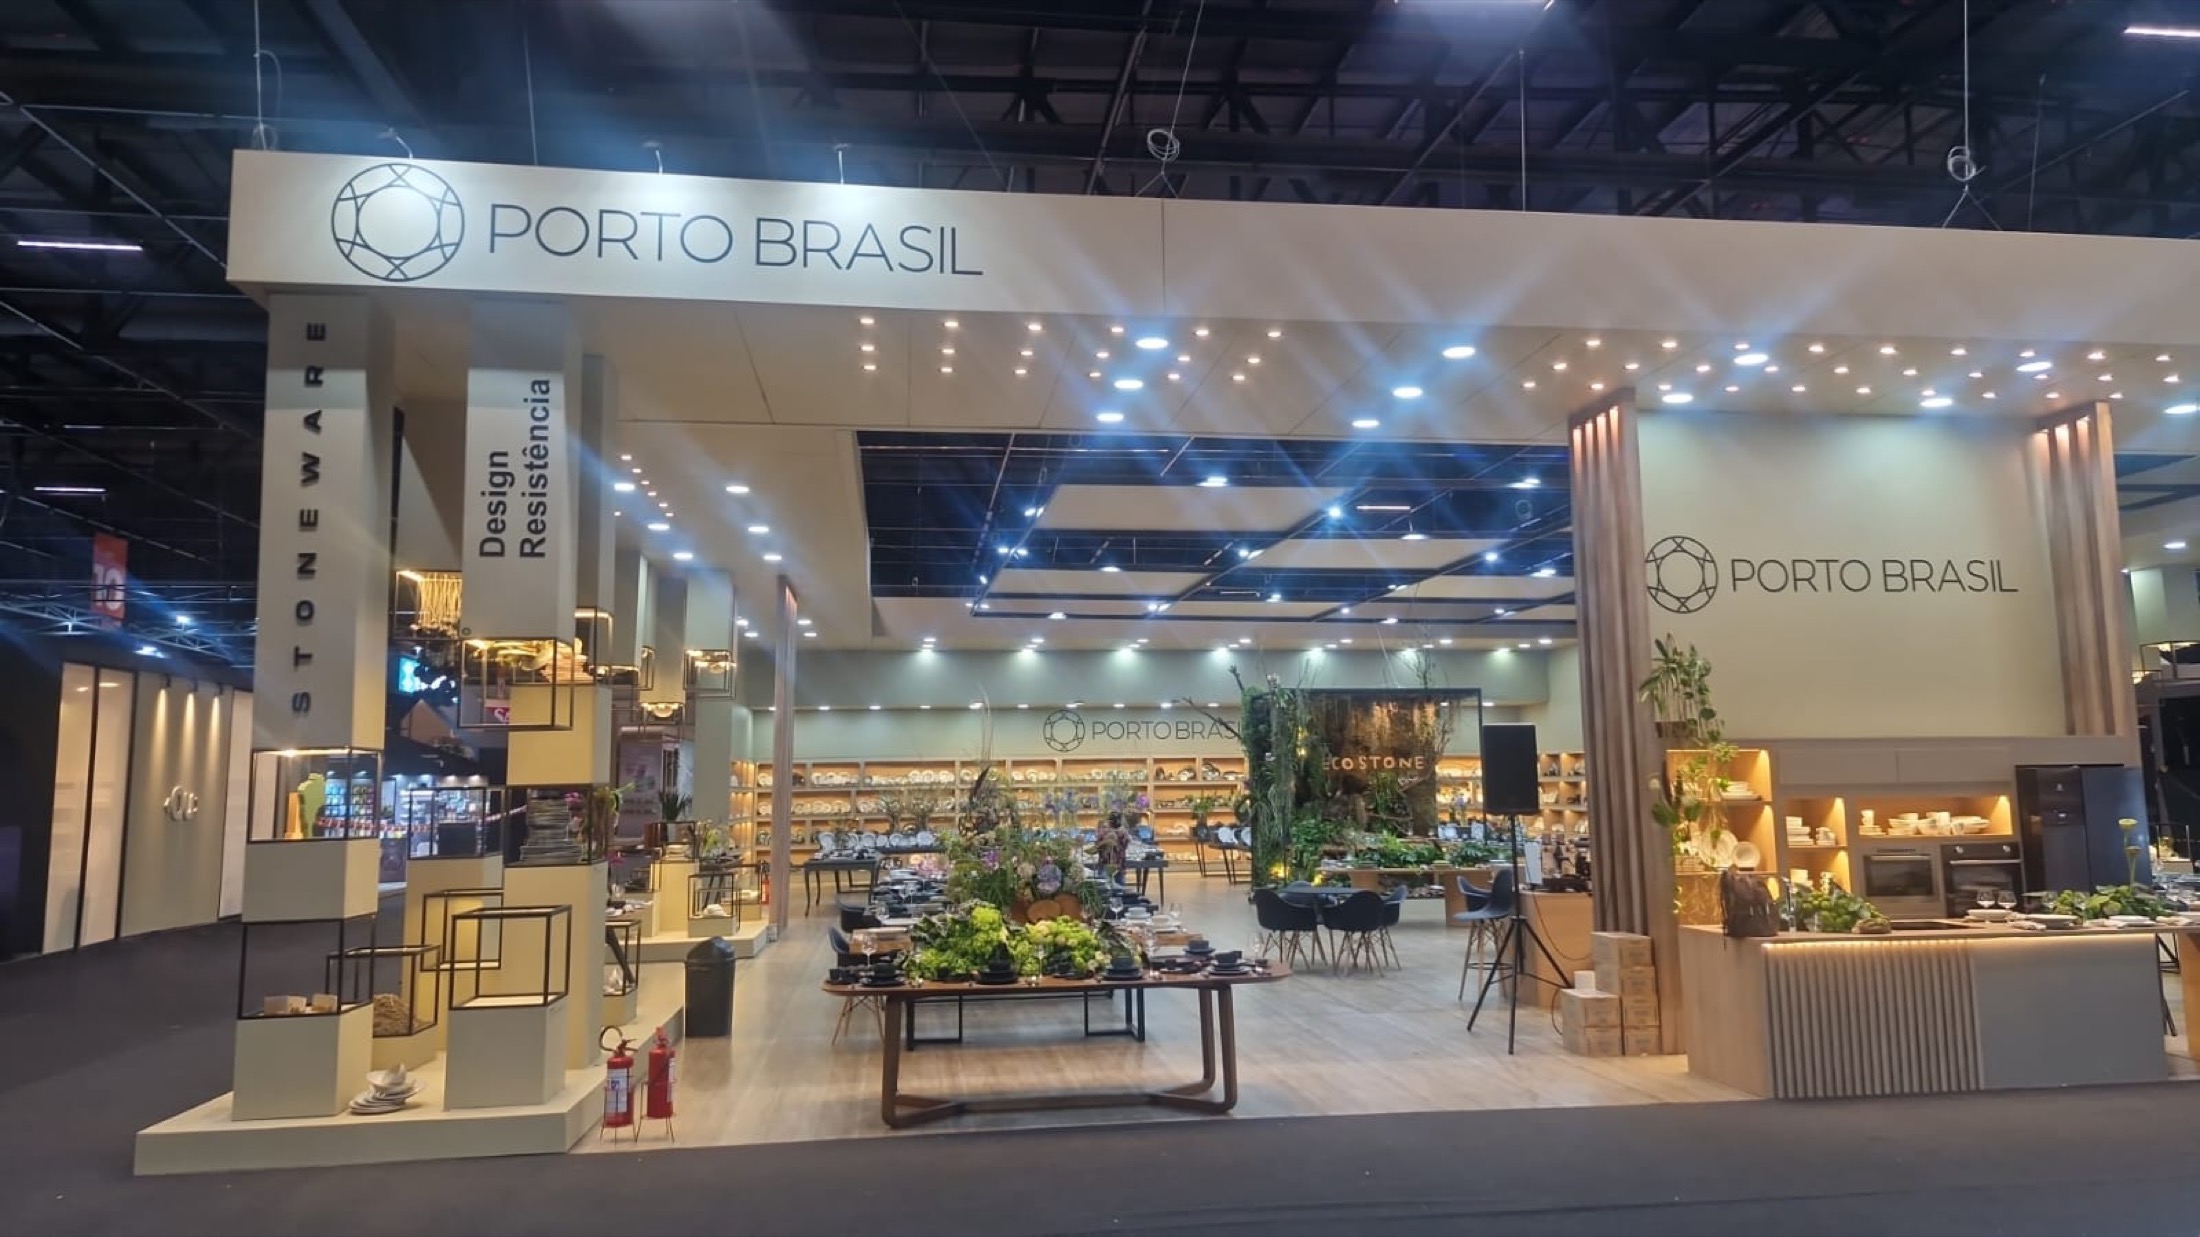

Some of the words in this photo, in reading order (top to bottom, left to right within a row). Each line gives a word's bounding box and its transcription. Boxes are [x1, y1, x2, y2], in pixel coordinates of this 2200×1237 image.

[489, 203, 734, 264] PORTO
[755, 217, 984, 276] BRASIL
[479, 450, 516, 558] Design
[519, 379, 551, 558] Resistência
[292, 321, 327, 716] STONEWARE
[1731, 558, 1872, 593] PORTO
[1882, 559, 2020, 593] BRASIL
[1091, 721, 1172, 740] PORTO
[1175, 720, 1241, 740] BRASI
